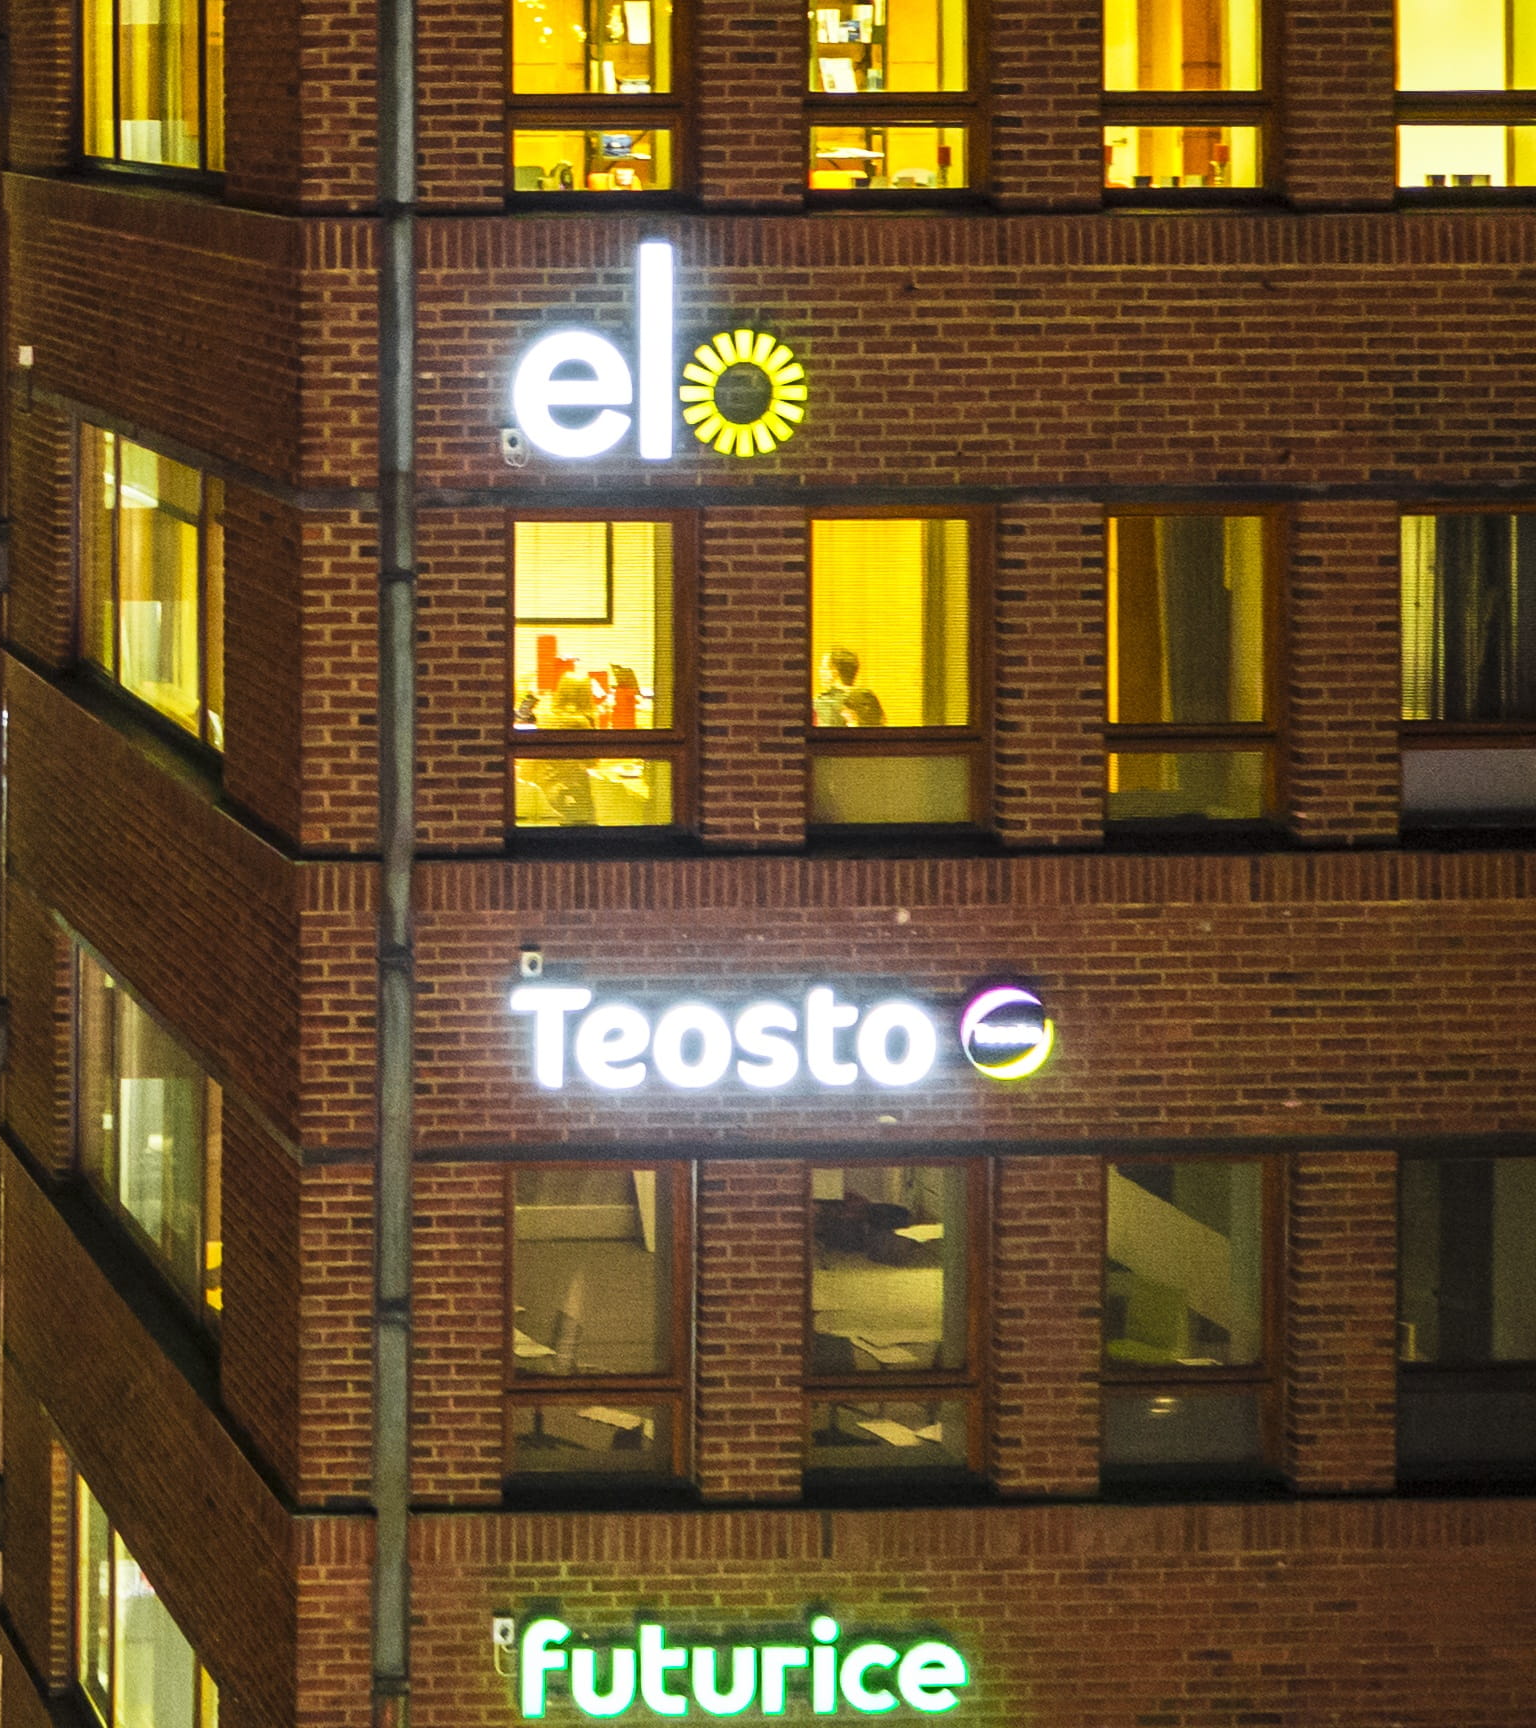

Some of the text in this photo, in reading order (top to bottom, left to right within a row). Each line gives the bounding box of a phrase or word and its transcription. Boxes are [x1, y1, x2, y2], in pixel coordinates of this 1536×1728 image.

[514, 241, 808, 460] elo
[510, 985, 939, 1090] Teosto
[521, 1616, 971, 1719] futurice
